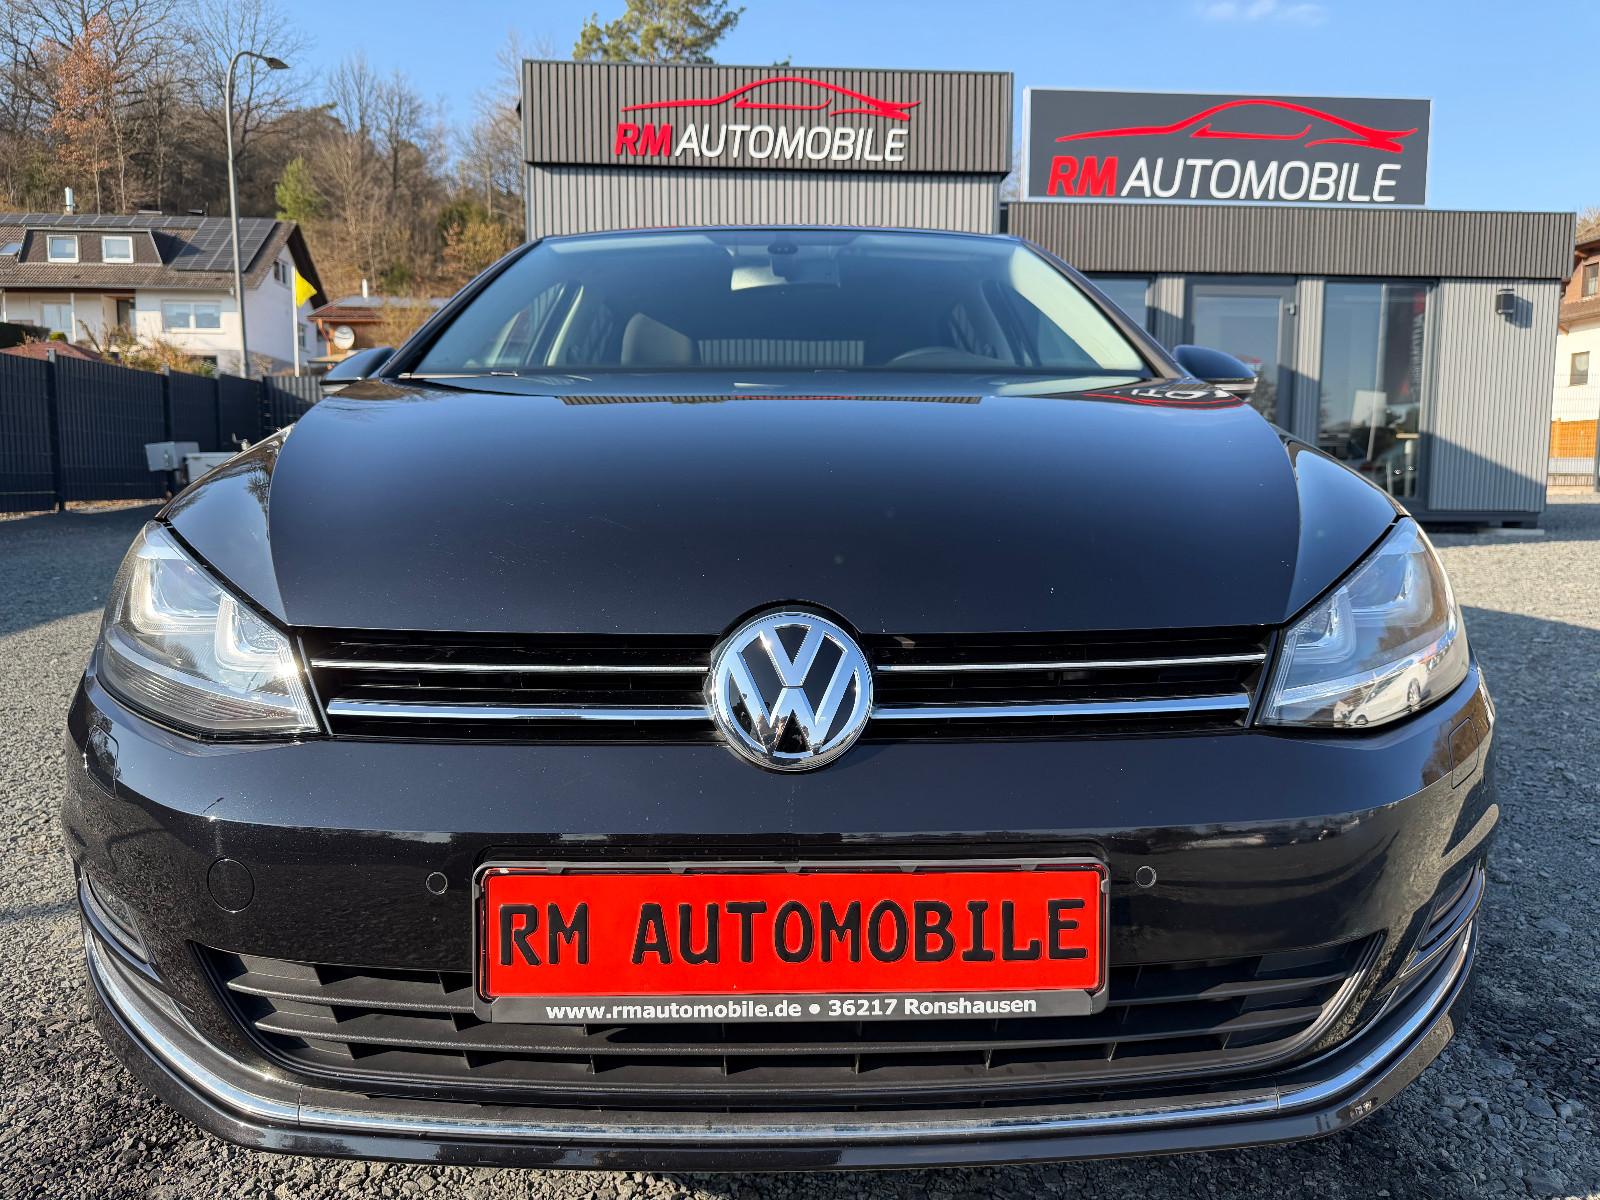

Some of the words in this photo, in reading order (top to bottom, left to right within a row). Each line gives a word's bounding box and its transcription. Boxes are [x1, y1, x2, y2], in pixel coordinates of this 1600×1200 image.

[614, 122, 673, 157] RM
[674, 123, 911, 163] AUTOMOBILE
[1046, 155, 1119, 197] RM
[1120, 156, 1402, 203] AUTOMOBILE
[499, 901, 590, 967] RM
[631, 898, 1089, 964] AUTOMOBILE
[545, 999, 802, 1020] www.rmautomobile.de
[828, 998, 898, 1016] 36217
[904, 997, 1038, 1015] Ronshausen
